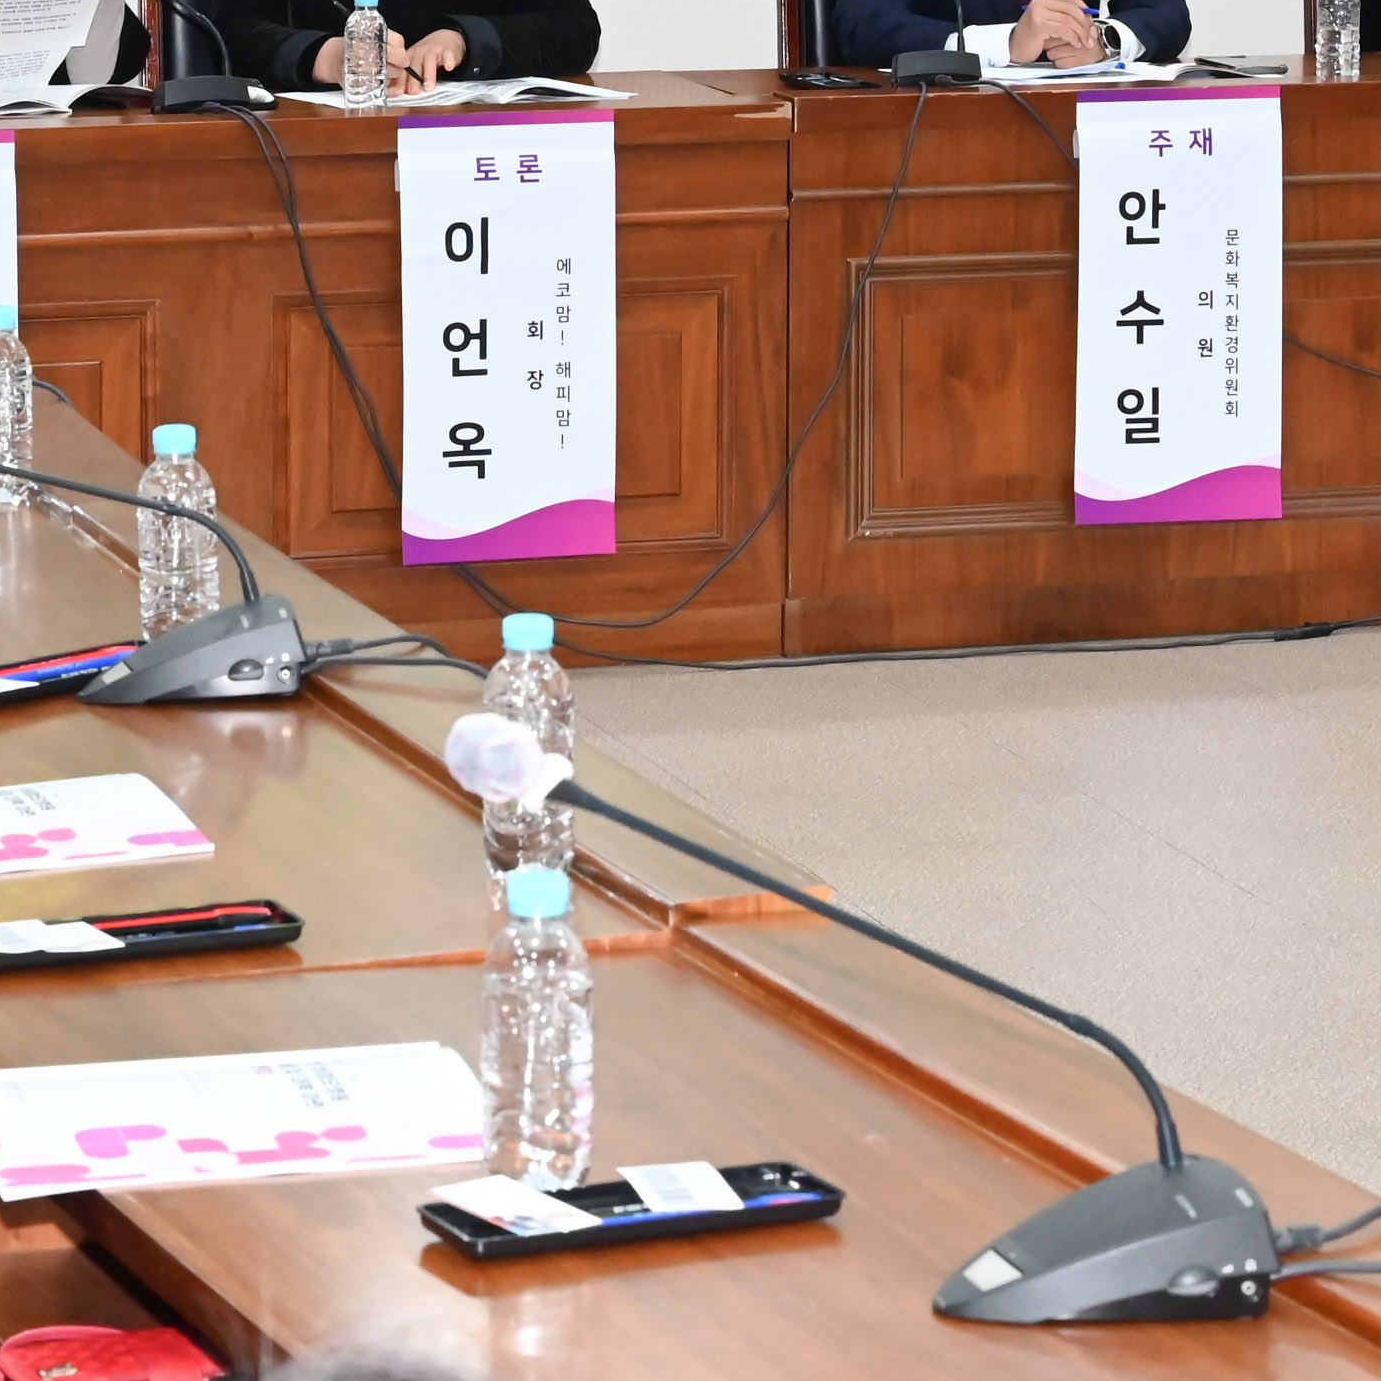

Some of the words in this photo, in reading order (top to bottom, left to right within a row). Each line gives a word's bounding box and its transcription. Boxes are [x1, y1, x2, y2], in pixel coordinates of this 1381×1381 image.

[474, 155, 542, 183] 토론
[1149, 128, 1212, 157] 주재
[556, 257, 572, 346] 에코맘!
[1116, 189, 1166, 444] 안수일
[1225, 230, 1239, 417] 문화복지환경위원회
[443, 217, 492, 479] 이언옥
[555, 361, 572, 449] 해피맘!
